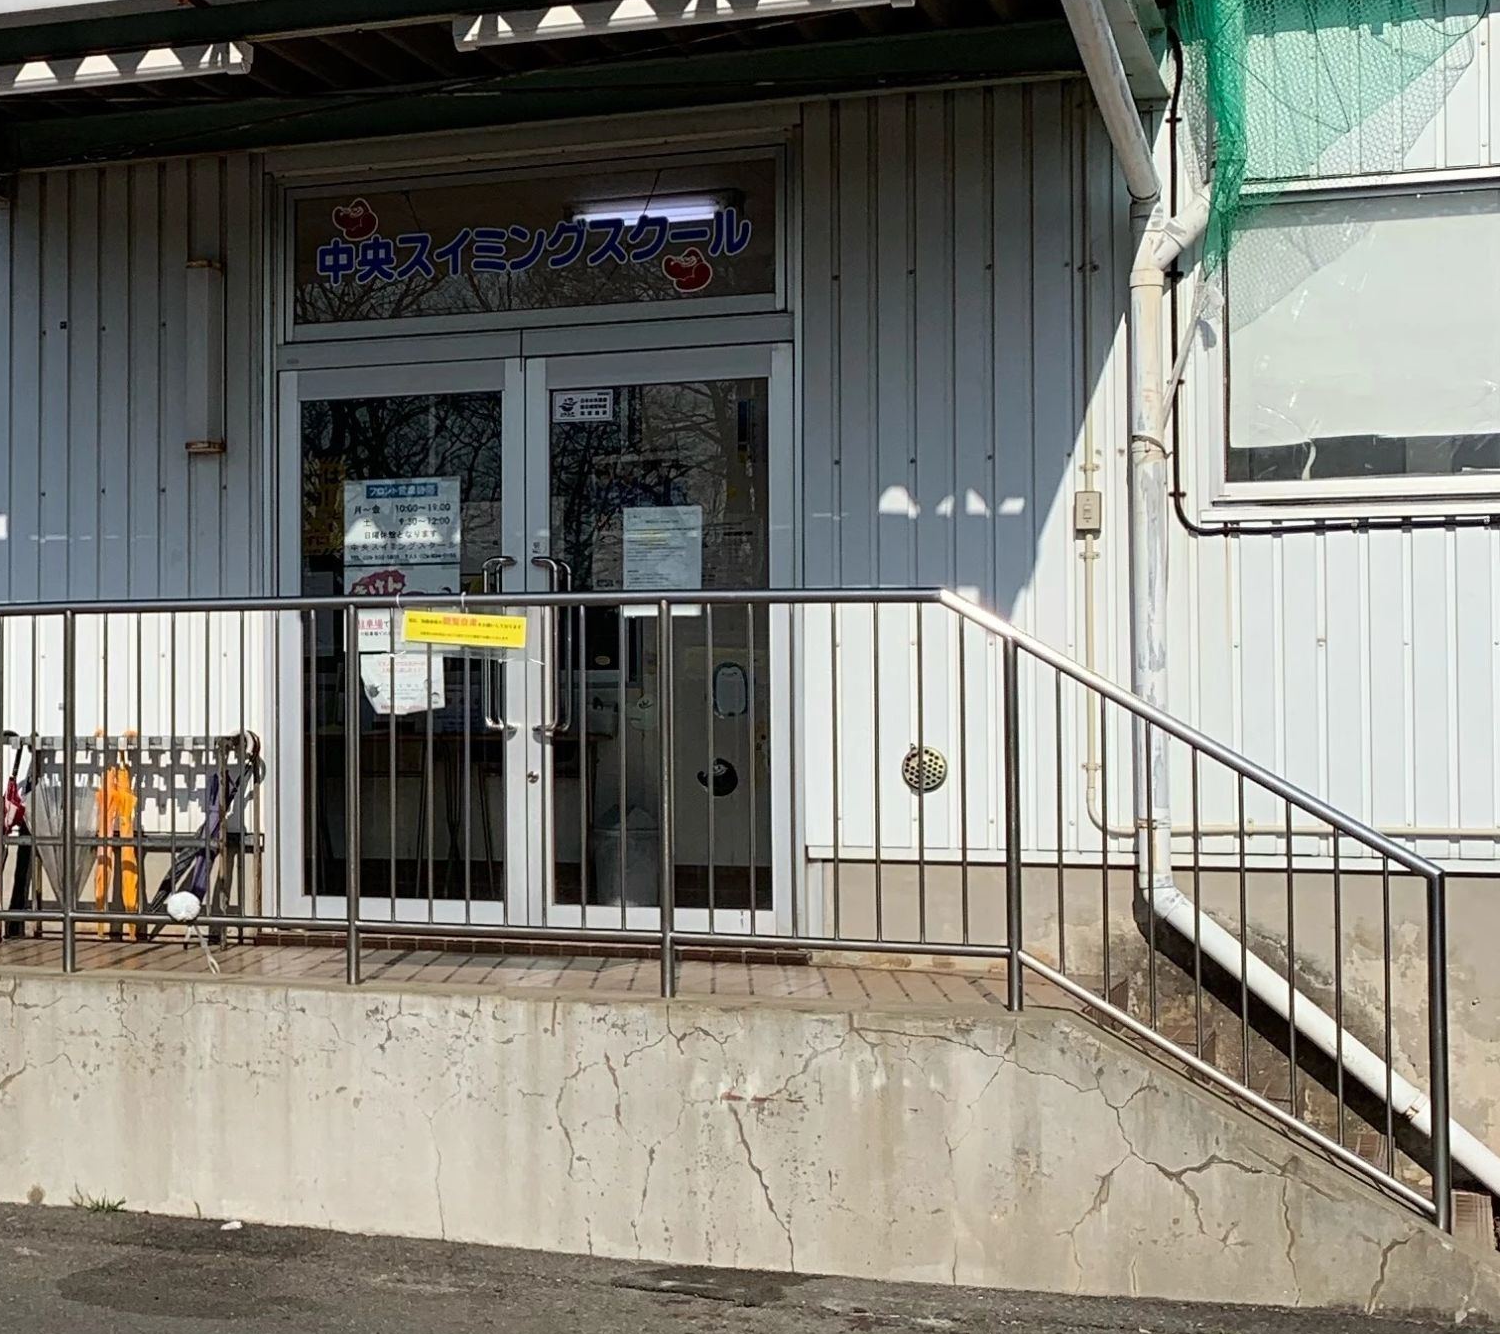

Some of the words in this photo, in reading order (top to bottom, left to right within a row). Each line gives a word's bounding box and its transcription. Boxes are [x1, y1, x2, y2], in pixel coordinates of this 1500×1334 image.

[317, 208, 751, 286] 中央スイミングスクール
